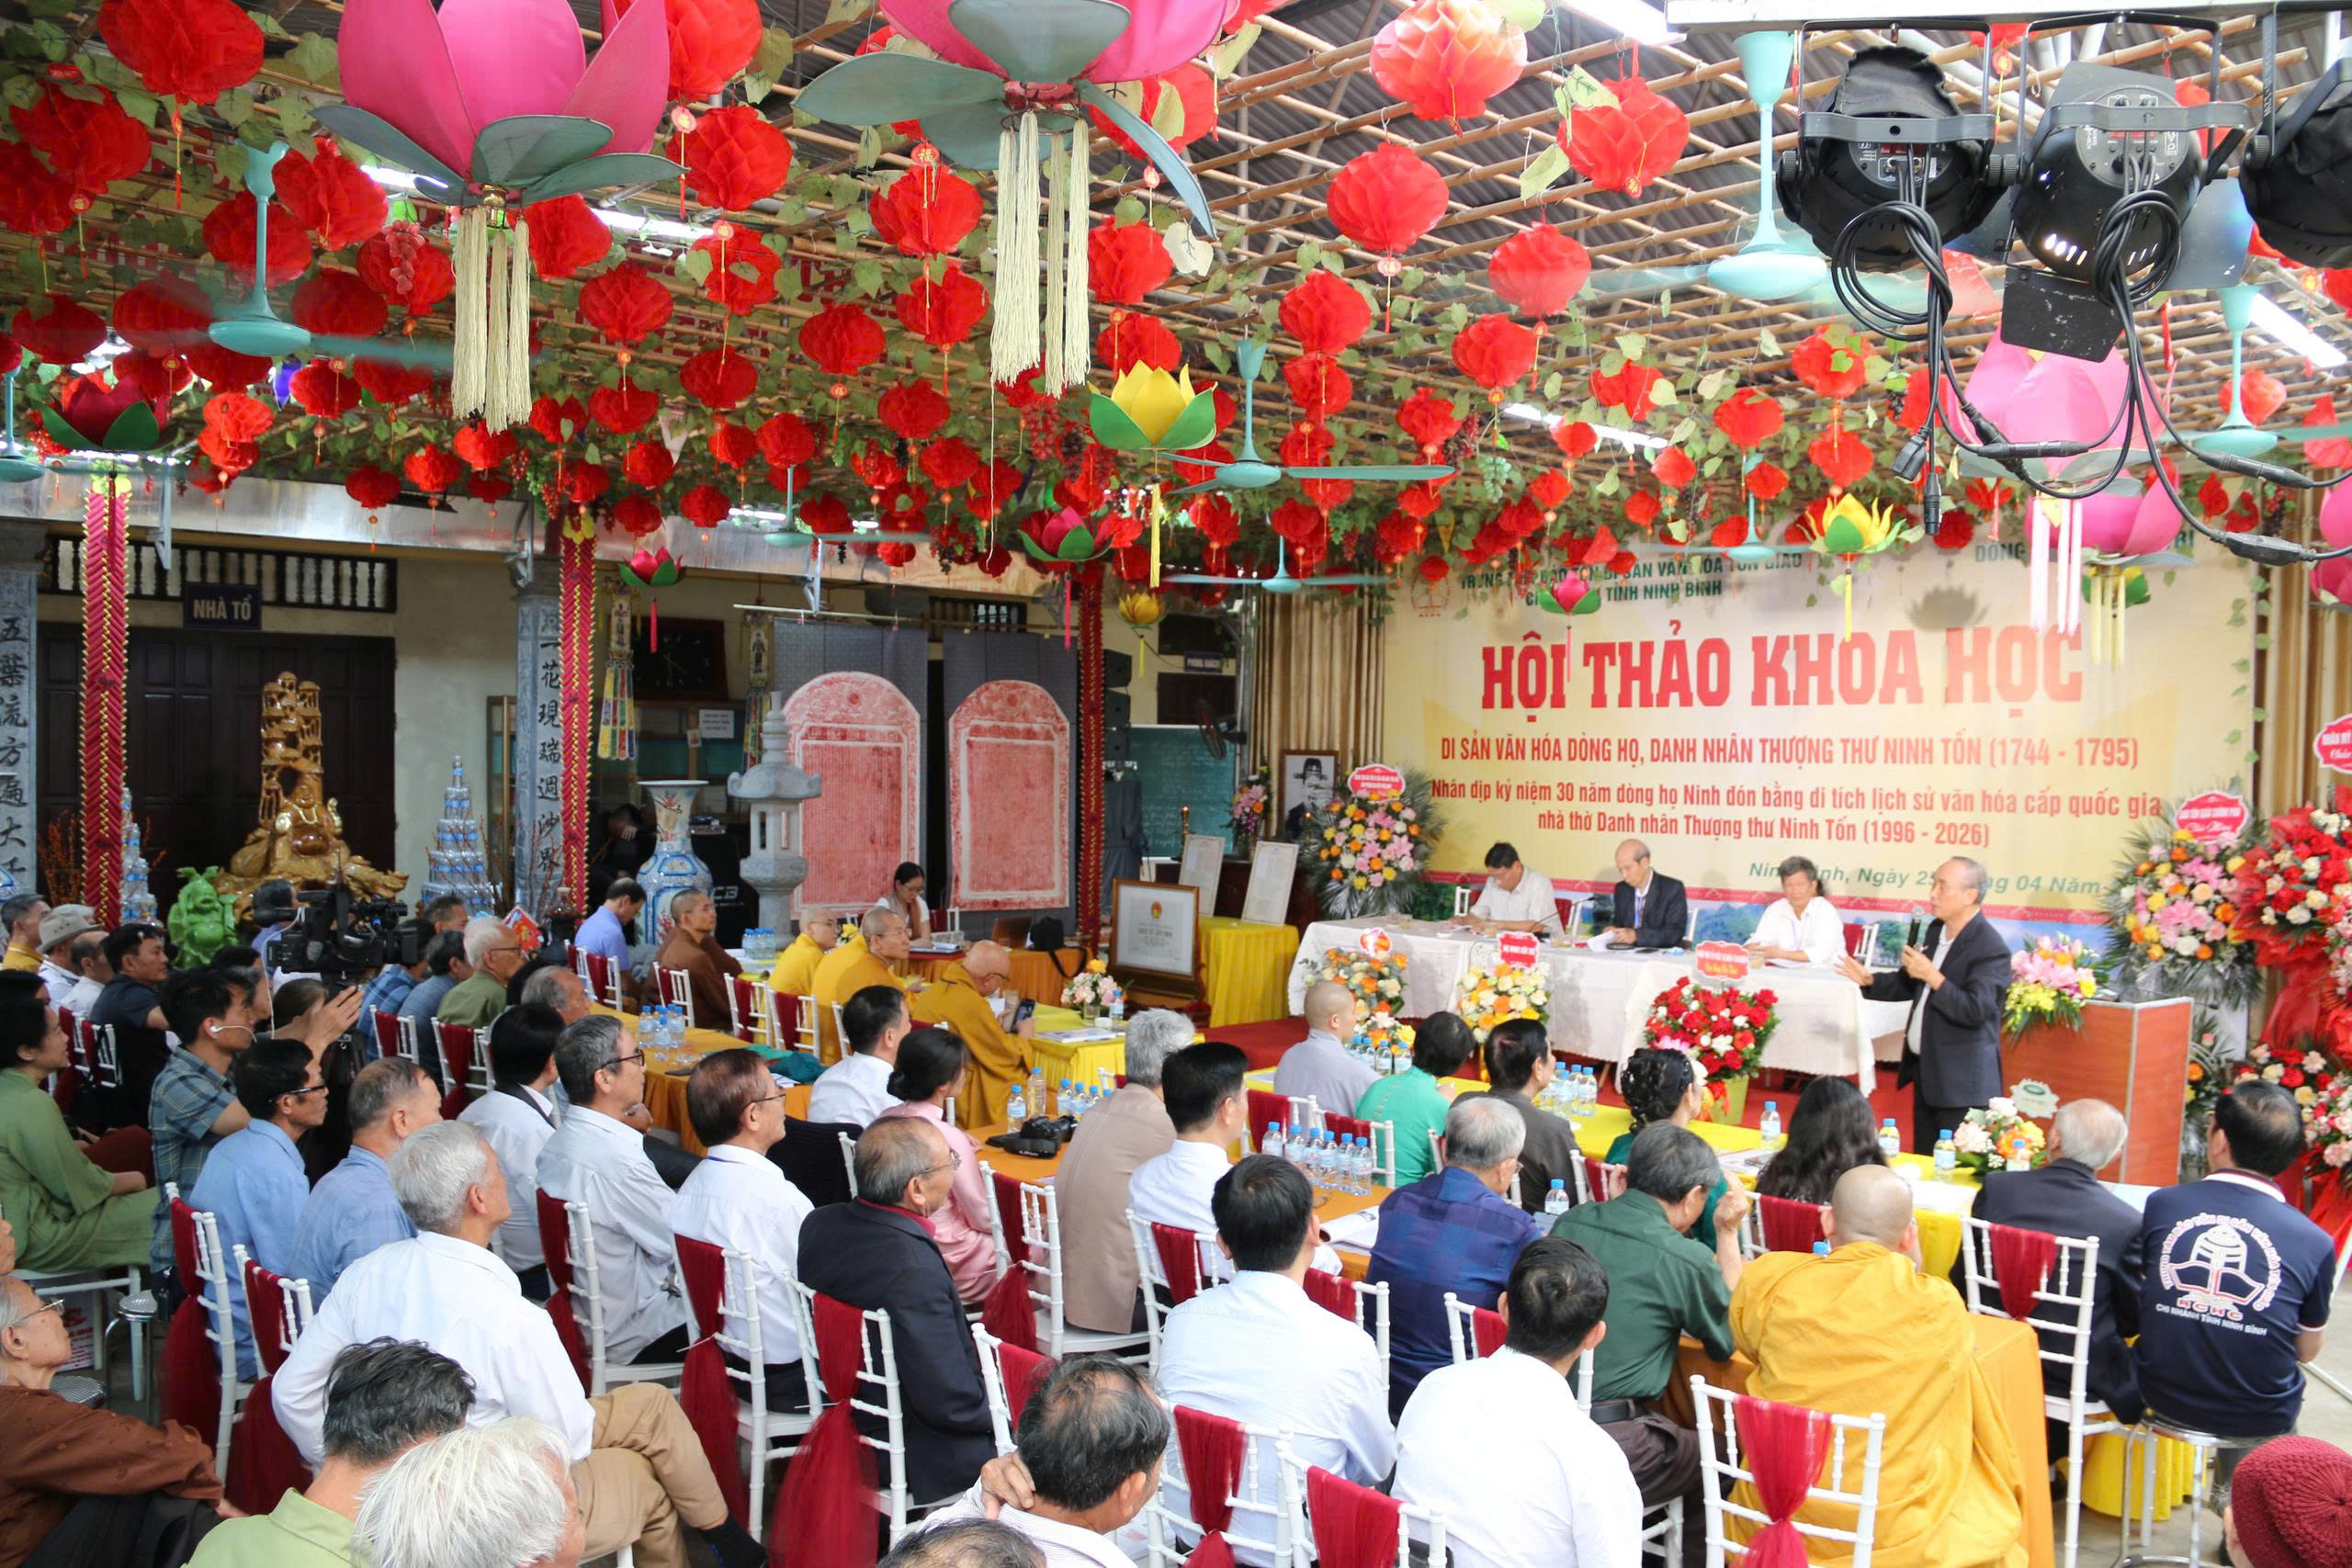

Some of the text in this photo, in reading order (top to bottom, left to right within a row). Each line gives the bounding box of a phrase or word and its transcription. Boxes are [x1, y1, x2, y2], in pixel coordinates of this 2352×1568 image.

[194, 593, 253, 620] NHÀ TỔ
[1644, 582, 1679, 600] NINH
[1482, 619, 2083, 722] HỘI THẢO KHOA HỌC
[1442, 737, 1455, 761] DI
[1461, 729, 1490, 761] SẢN
[1495, 732, 1526, 761] VĂN
[1532, 733, 1562, 762] HÓA
[1568, 732, 1611, 763] DÒNG
[1650, 737, 1697, 763] DANH
[1703, 734, 1753, 764] NHÂN
[1758, 736, 1834, 770] THƯỢNG
[1840, 737, 1880, 765] THƯ
[1883, 737, 1933, 765] NINH
[1942, 728, 1982, 766] TỐN
[1989, 738, 2051, 770] (1744
[2075, 737, 2139, 770] 1795)
[1431, 778, 1465, 799] Nhân
[1471, 780, 1490, 803] dịp
[1516, 780, 1551, 805] niệm
[1556, 782, 1574, 802] 30
[1579, 781, 1611, 803] năm
[1617, 782, 1654, 807] dòng
[1658, 784, 1678, 809] họ
[1683, 784, 1720, 807] Ninh
[1726, 784, 1756, 807] đón
[1762, 781, 1804, 810] bằng
[1810, 787, 1826, 809] di
[1832, 787, 1865, 810] tích
[1871, 787, 1906, 815] lịch
[1913, 785, 1936, 812] sử
[1940, 788, 1974, 814] văn
[1981, 788, 2017, 815] hóa
[2024, 785, 2061, 818] cấp
[2068, 786, 2120, 818] quốc
[2127, 791, 2162, 820] gia
[1539, 810, 1564, 830] nhà
[1569, 811, 1592, 831] thờ
[1597, 811, 1634, 834] Danh
[1640, 813, 1679, 835] nhân
[1683, 814, 1742, 840] Thượng
[1747, 816, 1774, 838] thư
[1780, 818, 1819, 840] Ninh
[1826, 815, 1856, 841] Tốn
[1863, 819, 1915, 844] (1996
[1935, 822, 1989, 848] 2026)
[1749, 862, 1781, 878] Nin
[1858, 868, 1911, 888] Ngày
[2017, 875, 2041, 890] 04
[2049, 874, 2103, 895] Năm
